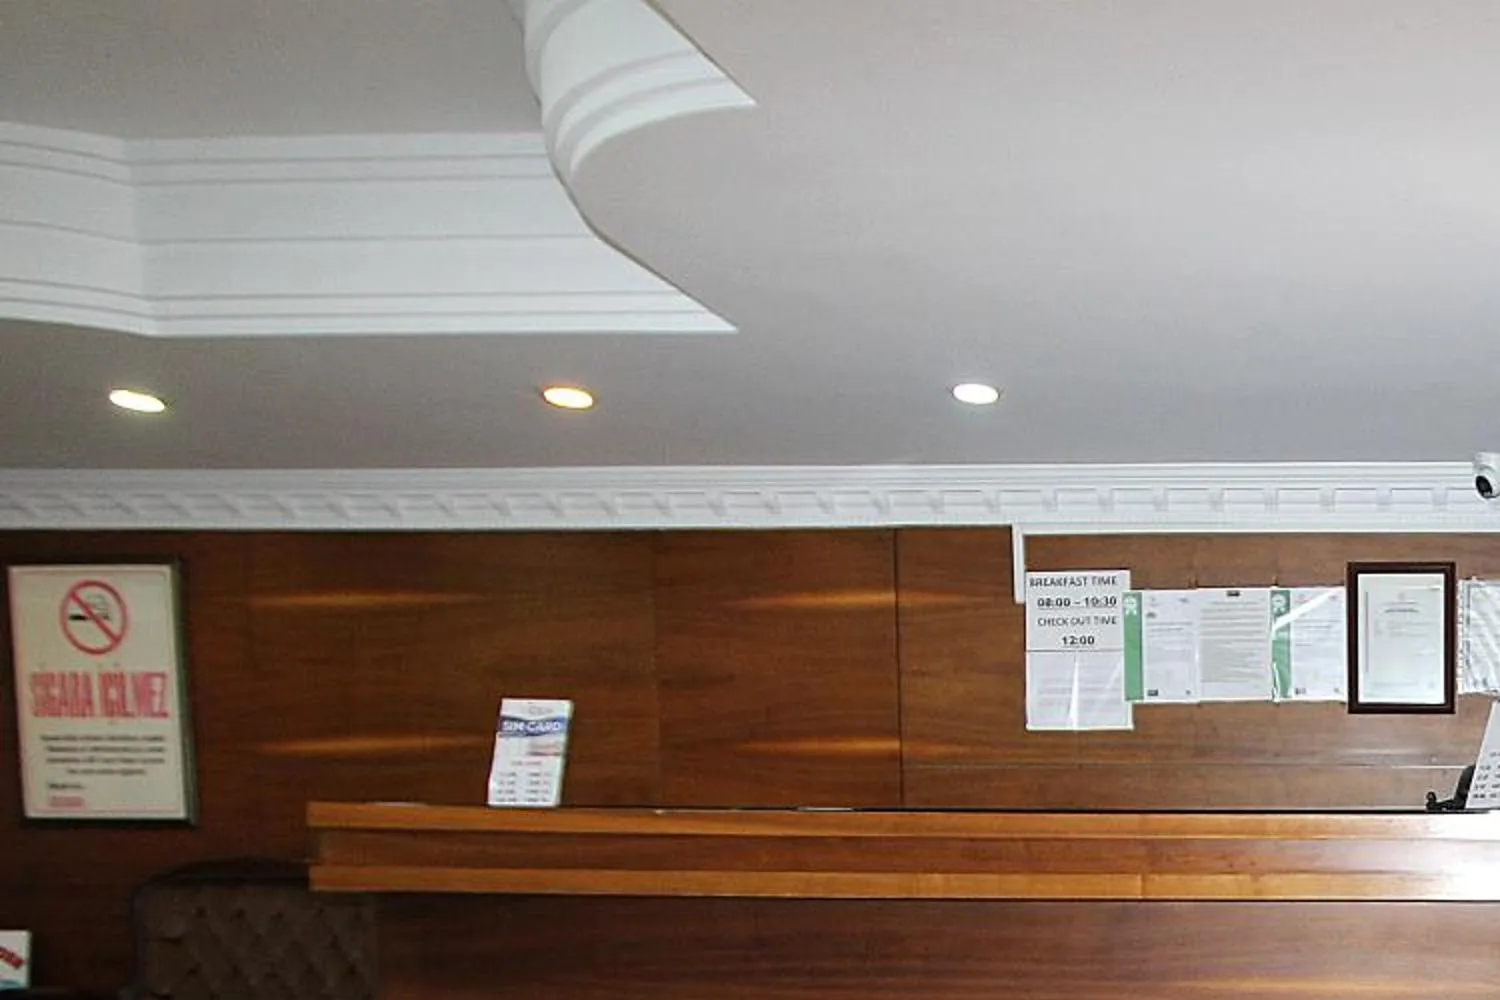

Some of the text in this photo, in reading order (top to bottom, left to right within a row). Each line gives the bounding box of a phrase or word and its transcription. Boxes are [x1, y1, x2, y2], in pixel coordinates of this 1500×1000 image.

[1029, 575, 1118, 587] BREAKFAST TIME
[1037, 597, 1071, 608] 08:00
[1084, 596, 1118, 607] 10:30
[1037, 615, 1118, 627] CHECK OUT TIME
[1061, 635, 1095, 645] 12:00
